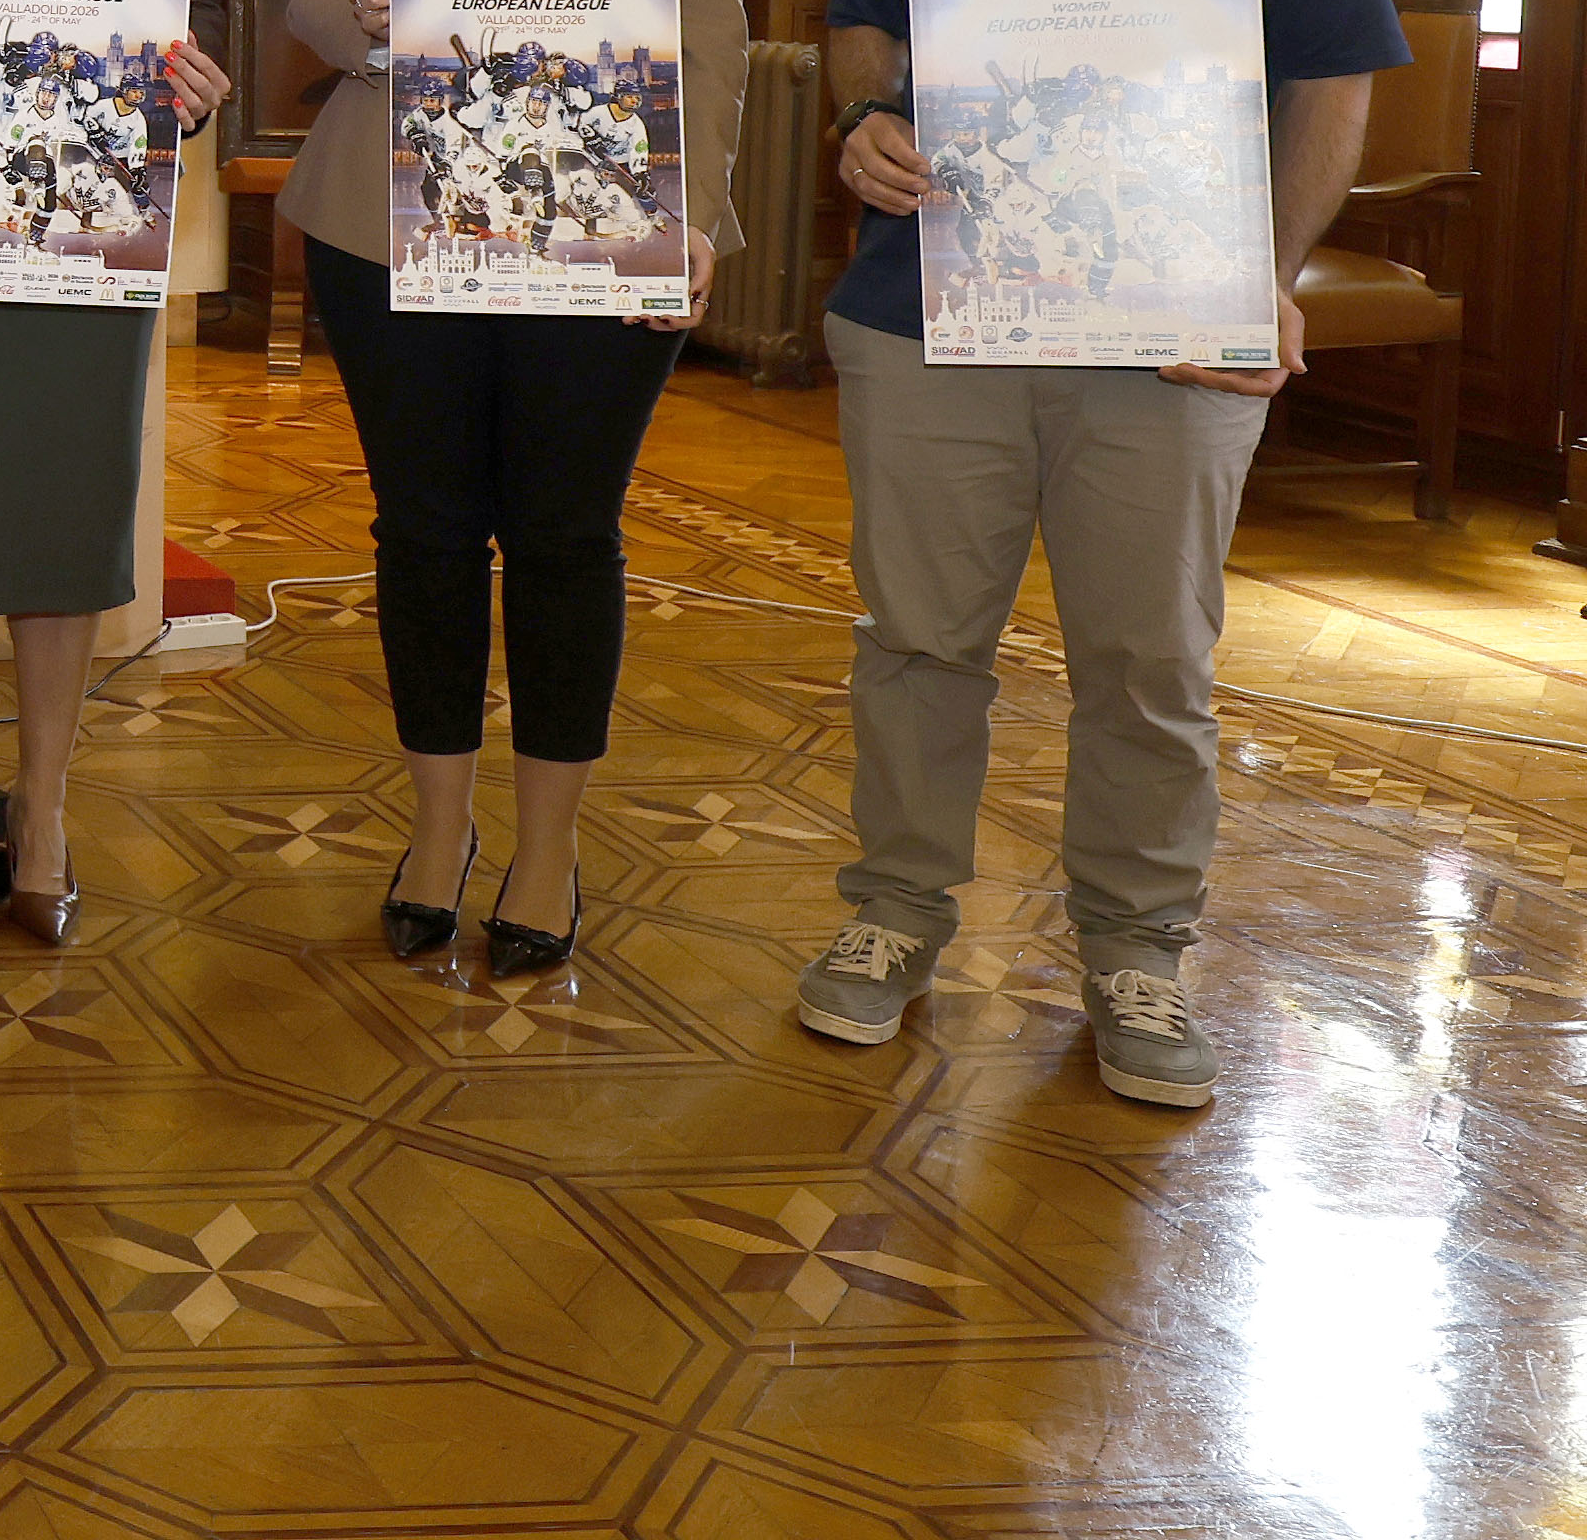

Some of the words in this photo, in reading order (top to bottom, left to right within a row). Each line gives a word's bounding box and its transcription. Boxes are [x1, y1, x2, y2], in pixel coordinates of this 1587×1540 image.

[70, 6, 100, 16] 2026
[1052, 1, 1111, 12] WOMEN
[62, 17, 82, 25] MAY
[476, 15, 553, 25] VALLADOLID
[555, 15, 586, 25] 2026
[986, 15, 1095, 33] EUROPEAN
[58, 288, 92, 296] UEMC
[569, 298, 606, 306] UEMC
[1135, 348, 1179, 356] UEMC
